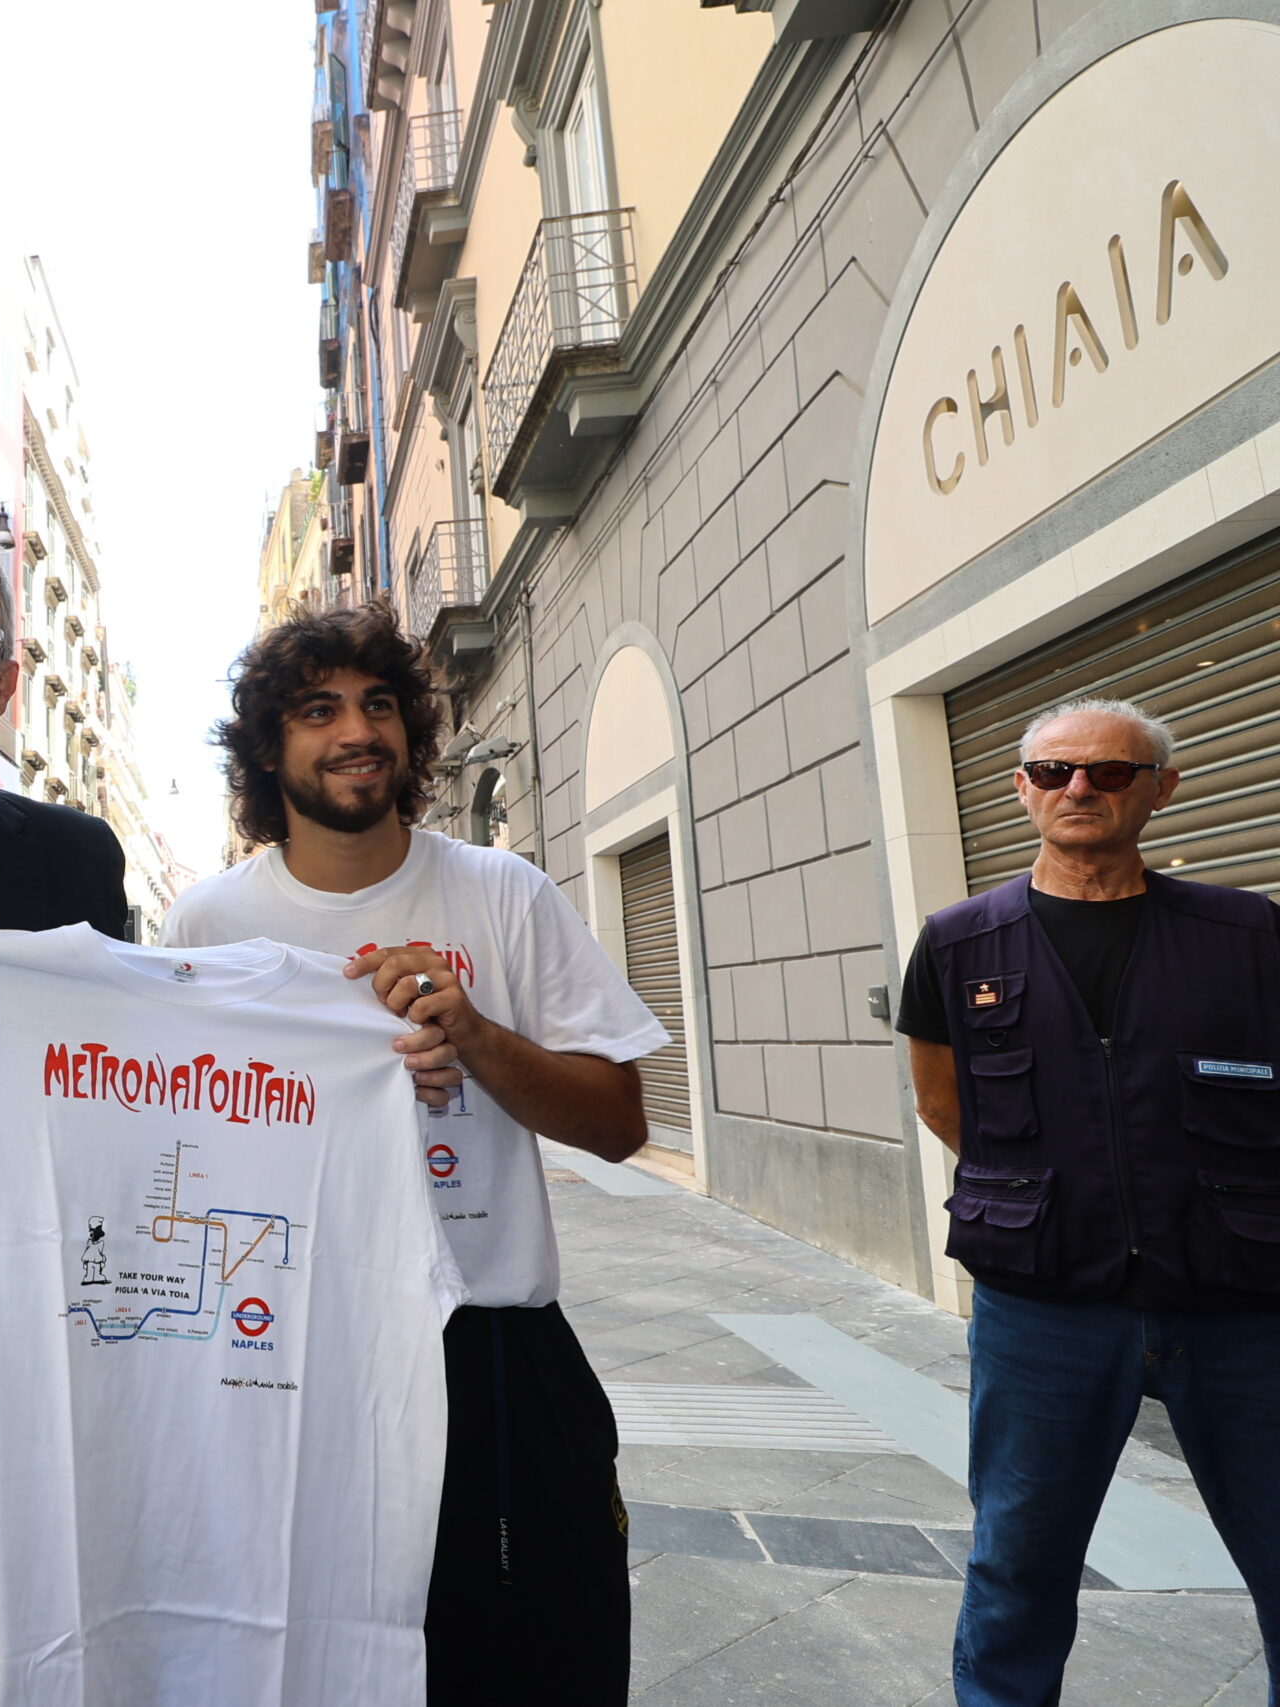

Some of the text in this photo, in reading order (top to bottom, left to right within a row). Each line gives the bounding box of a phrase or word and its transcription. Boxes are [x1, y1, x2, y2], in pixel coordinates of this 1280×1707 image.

[923, 179, 1229, 495] CHIAIA
[1203, 1064, 1230, 1072] POLIZIA
[44, 1043, 315, 1127] METRONAPOLITAIN
[433, 1180, 462, 1189] APLES
[119, 1272, 186, 1285] TAKE YOUR WAY
[151, 1289, 166, 1297] VIA
[169, 1290, 190, 1299] TOIA
[232, 1312, 272, 1321] UNDERGROUND
[231, 1339, 274, 1351] NAPLES
[277, 1381, 298, 1391] mobile
[500, 1518, 509, 1571] LA GALAXY
